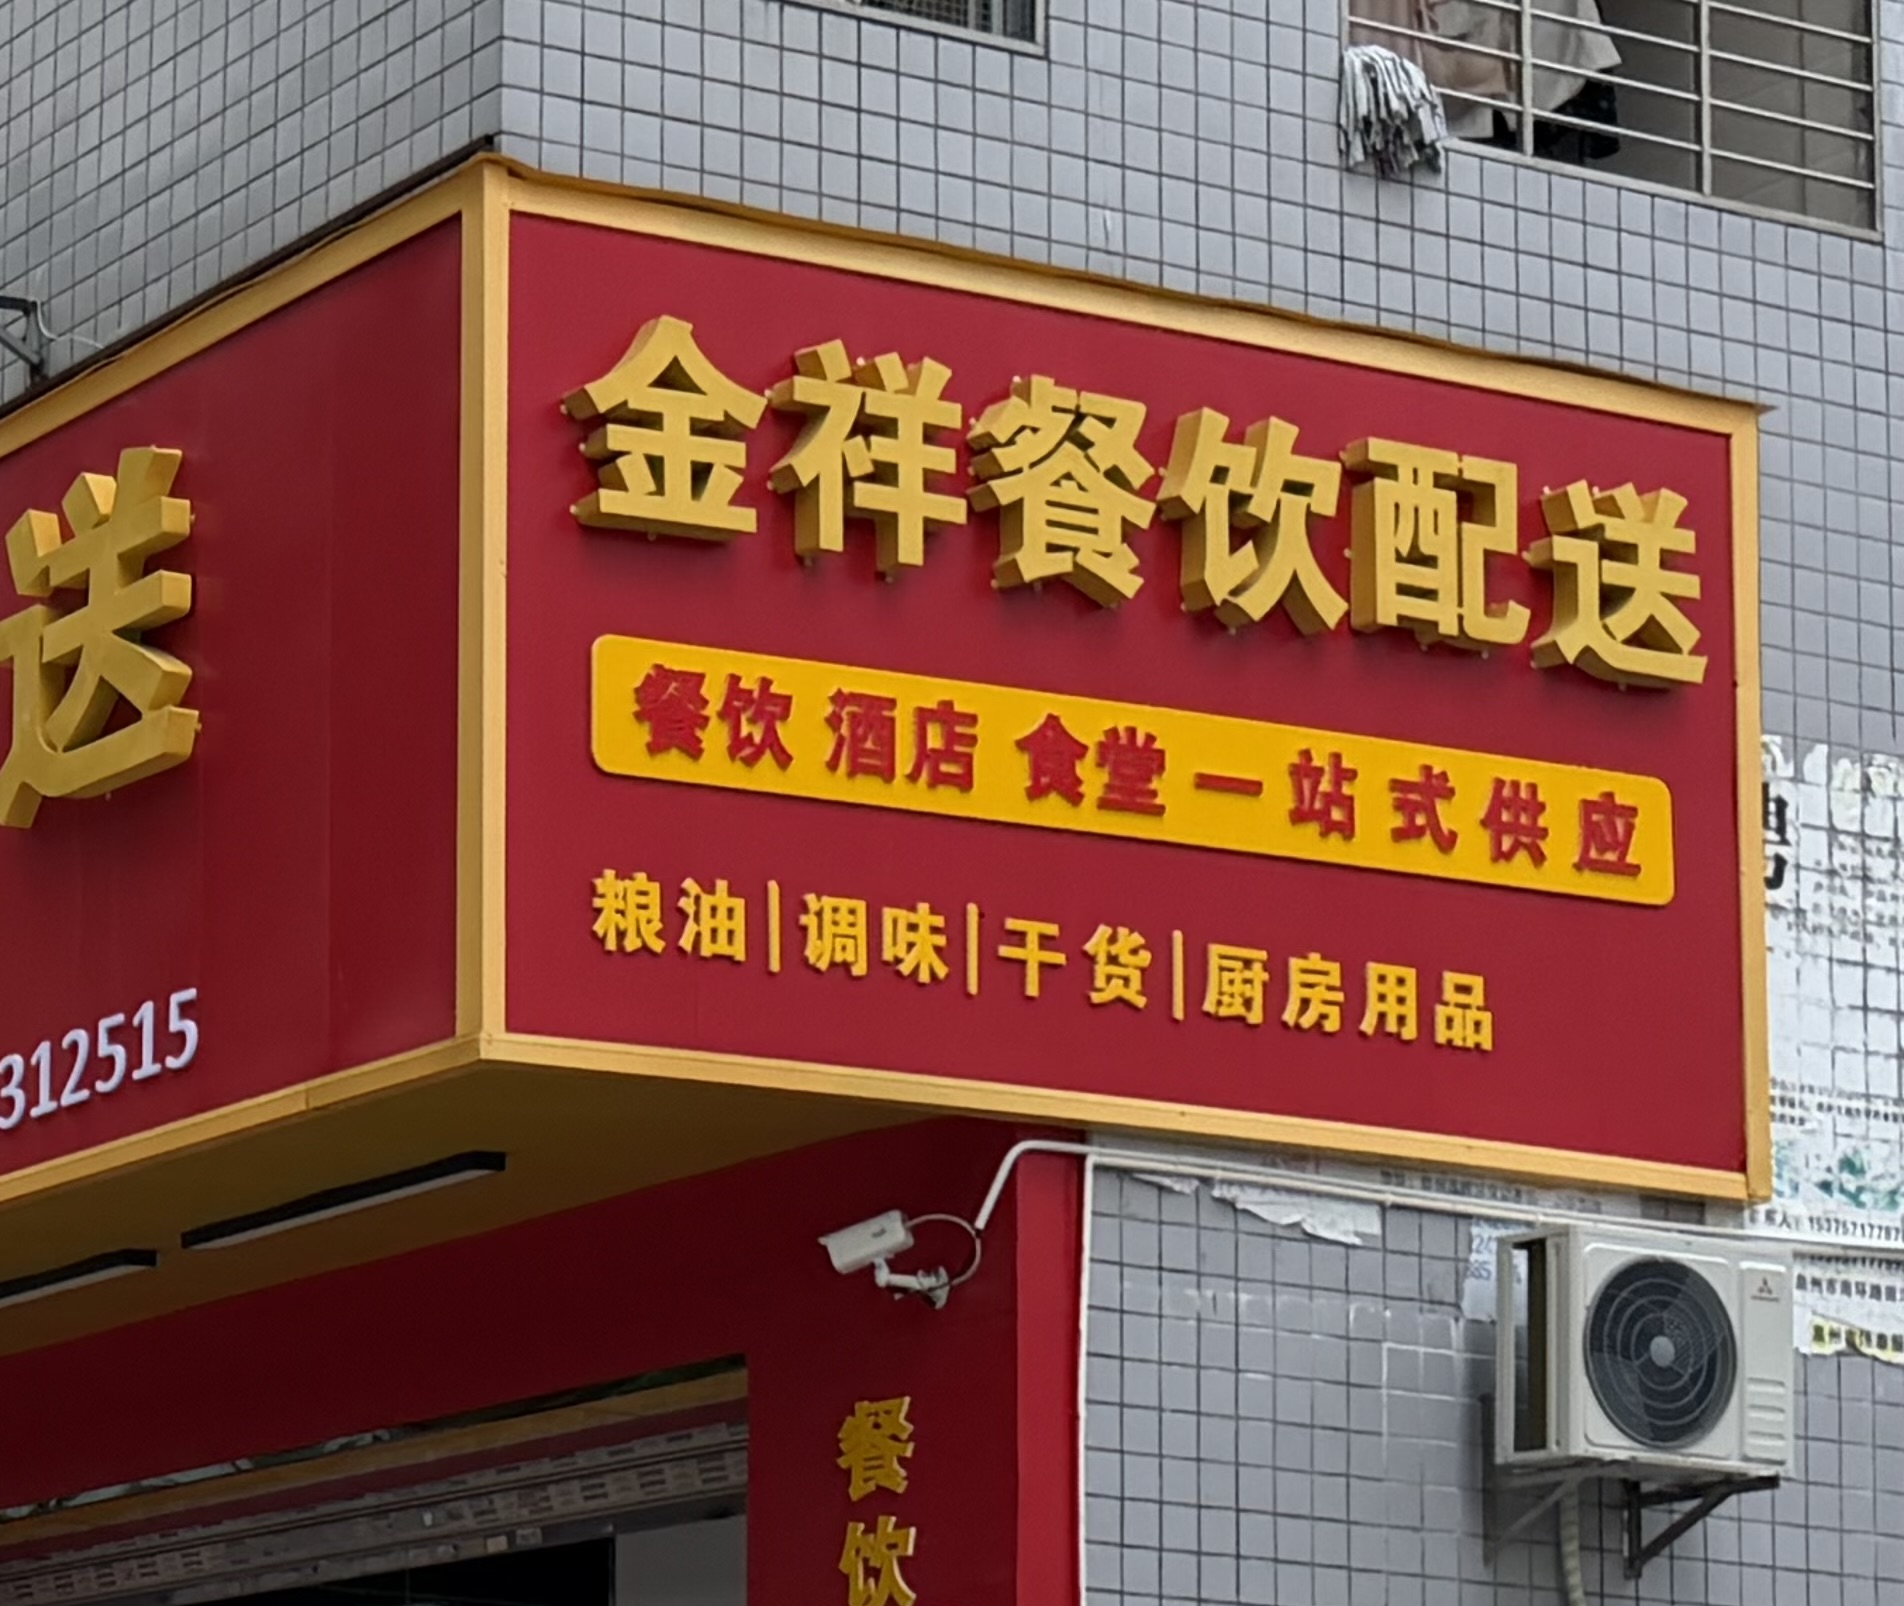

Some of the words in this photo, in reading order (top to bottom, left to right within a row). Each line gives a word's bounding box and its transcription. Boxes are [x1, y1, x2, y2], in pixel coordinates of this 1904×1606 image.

[563, 314, 1710, 689] 金祥餐饮配送
